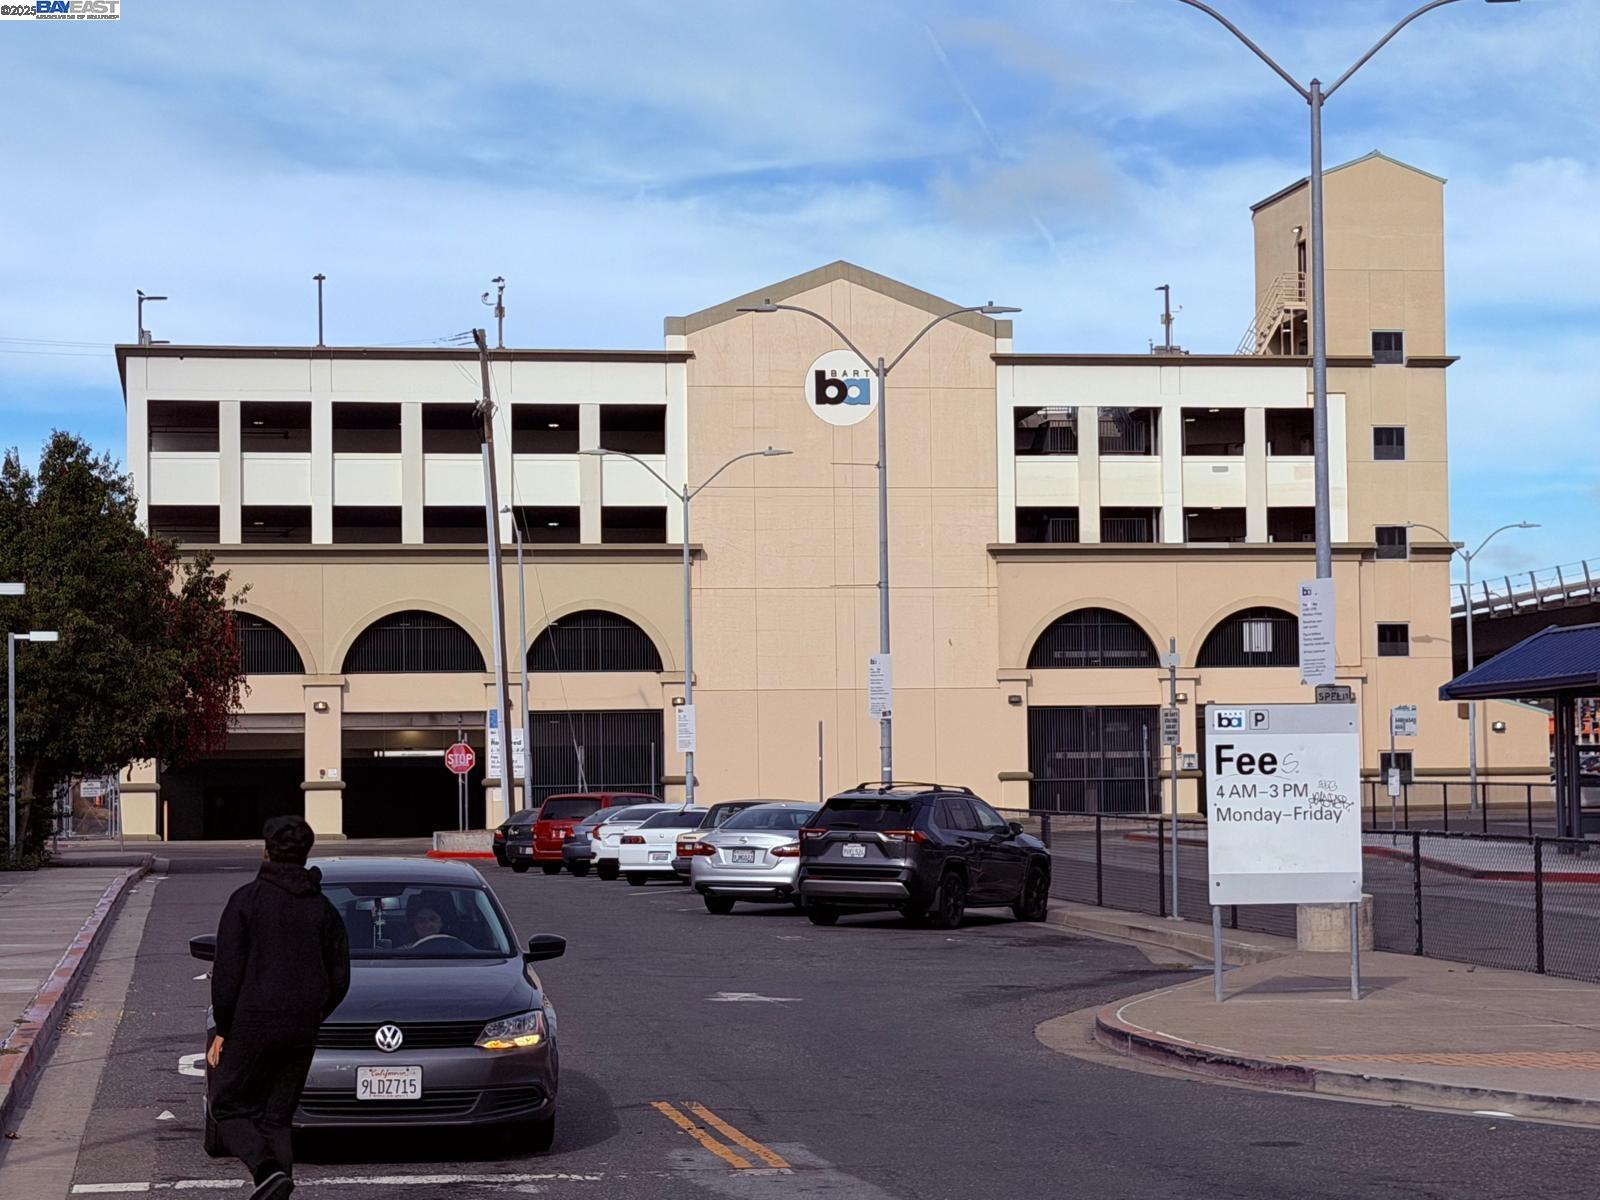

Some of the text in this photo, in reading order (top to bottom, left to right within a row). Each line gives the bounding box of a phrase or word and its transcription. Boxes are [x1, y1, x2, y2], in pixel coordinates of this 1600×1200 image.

[830, 369, 870, 378] BART
[1254, 712, 1265, 727] P
[447, 753, 473, 765] STOP
[1215, 744, 1278, 775] Fee
[1216, 785, 1225, 798] 4
[1283, 783, 1308, 798] PM
[1216, 805, 1343, 825] Monday–Friday
[361, 1079, 417, 1095] 9LDZ715
